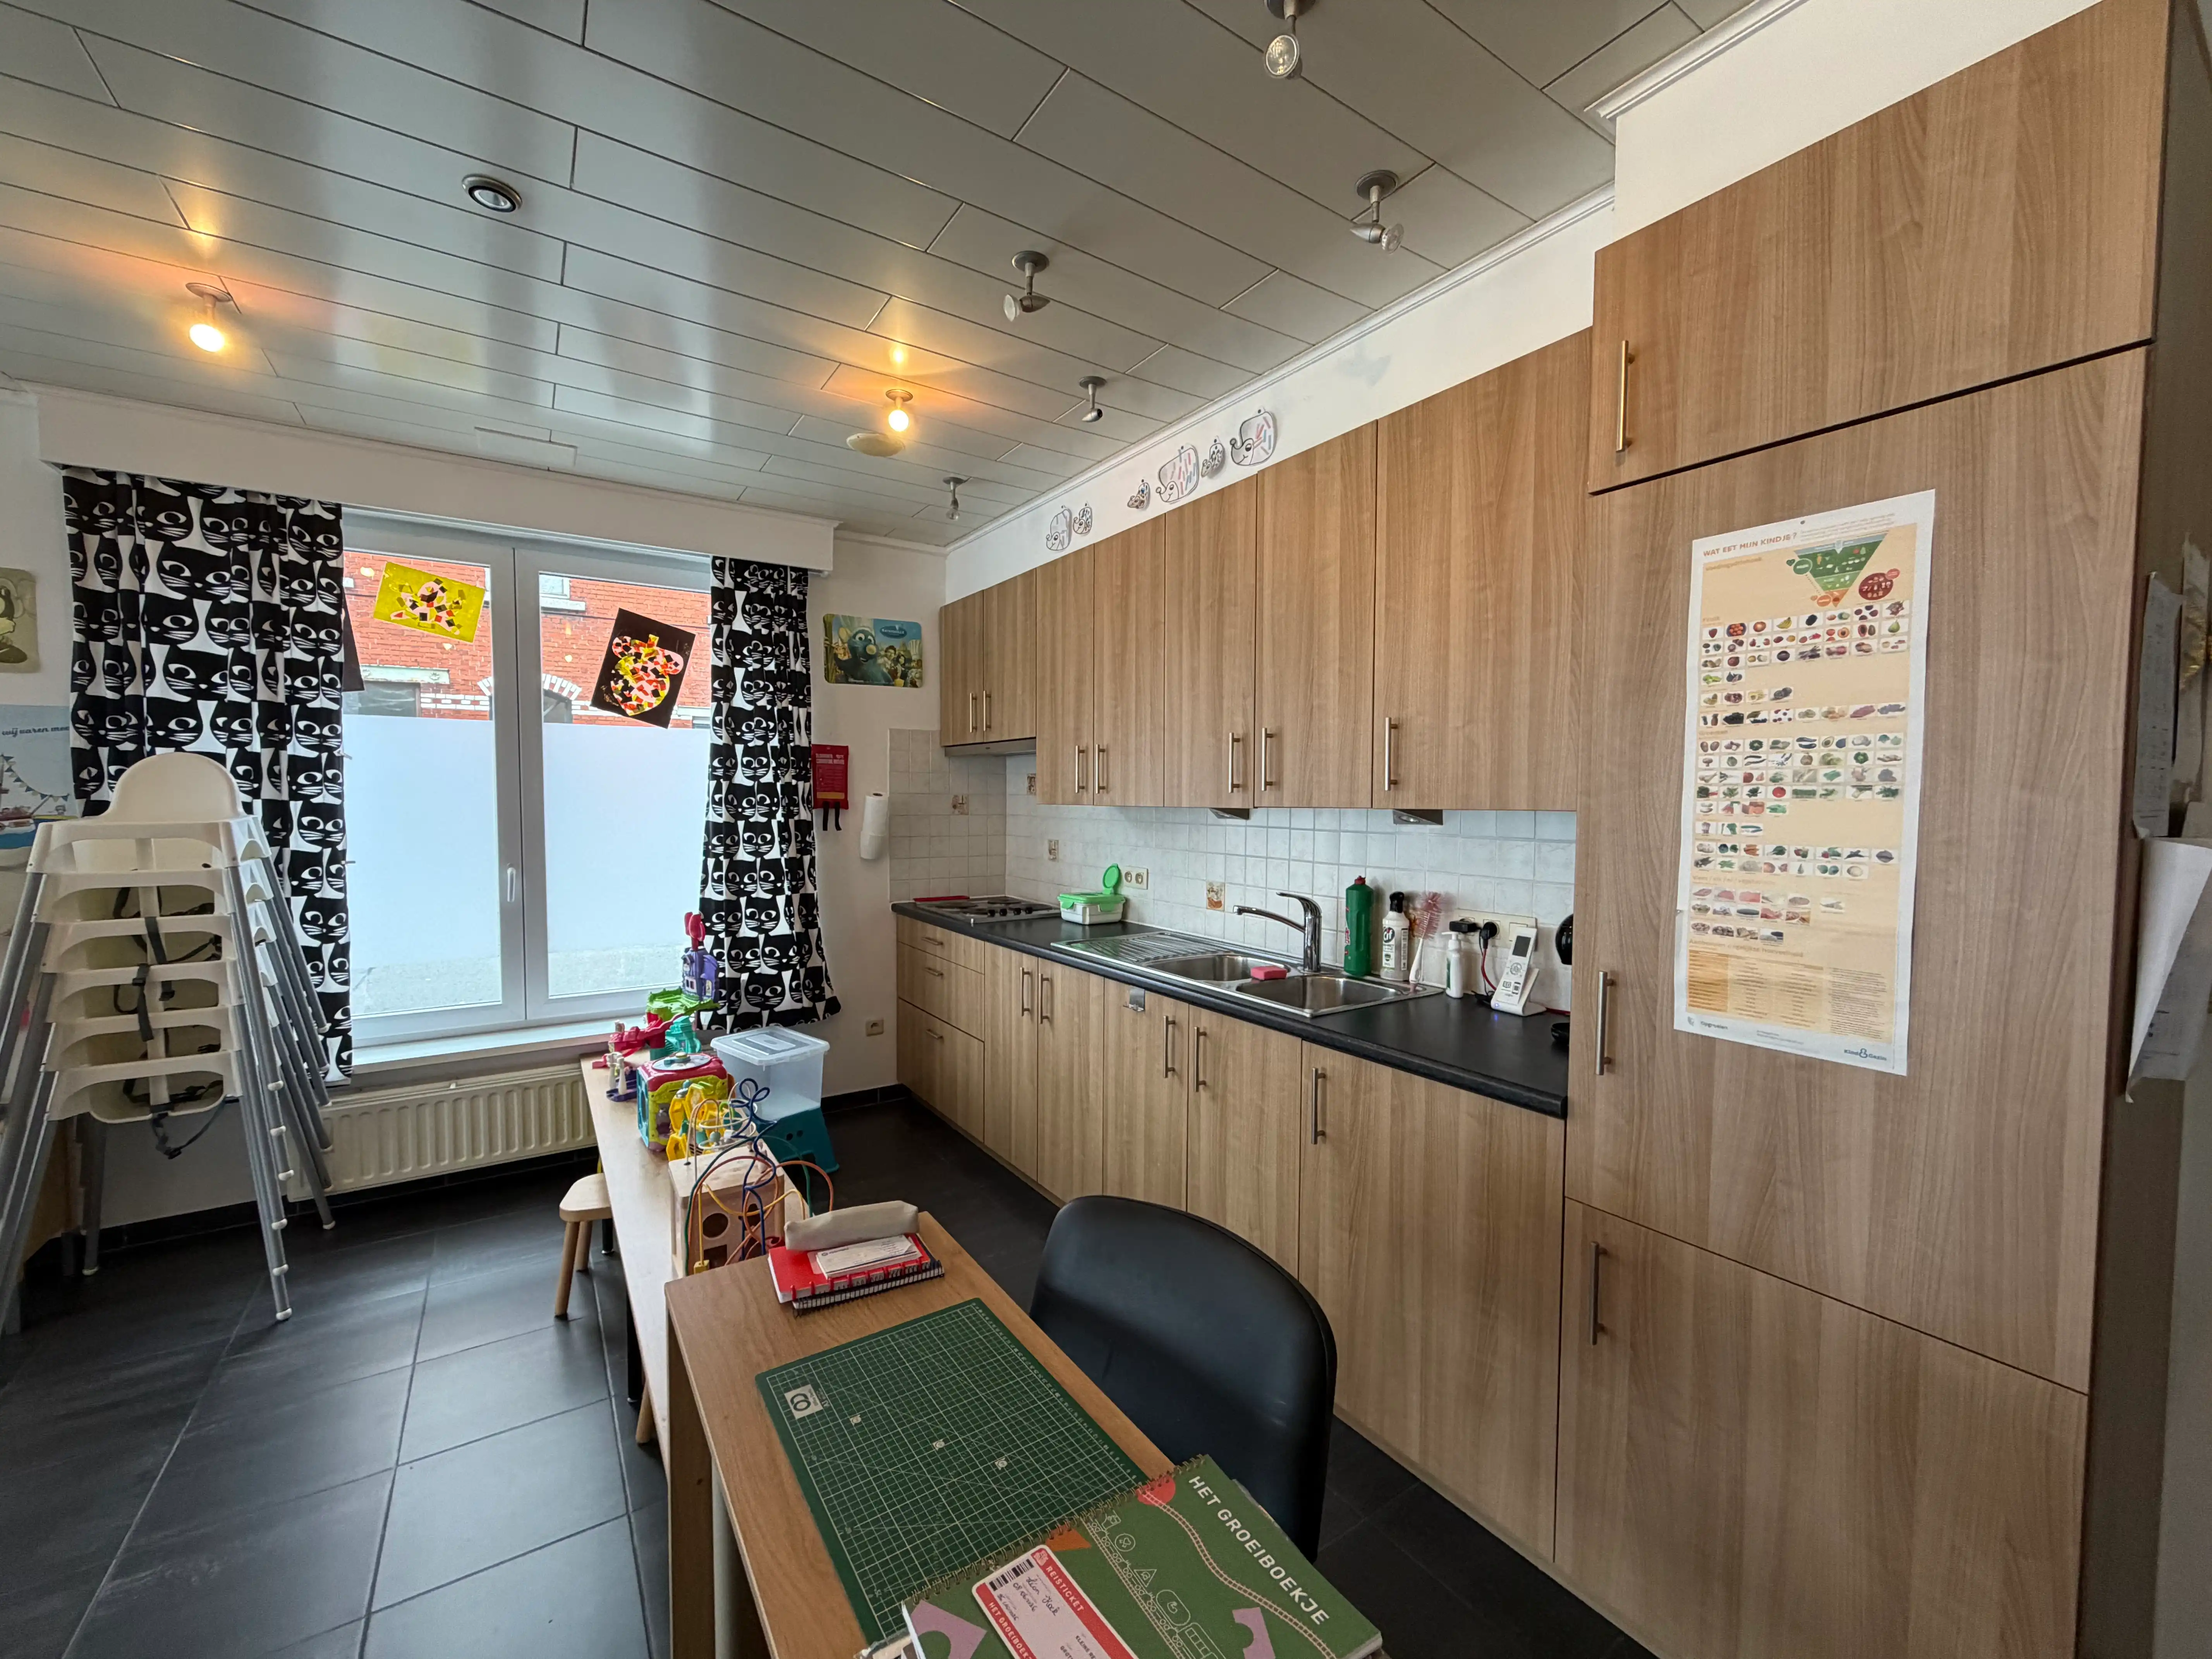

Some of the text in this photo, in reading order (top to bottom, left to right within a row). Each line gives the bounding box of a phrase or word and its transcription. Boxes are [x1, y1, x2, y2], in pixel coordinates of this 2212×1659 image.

[1703, 548, 1720, 556] WAT
[1723, 544, 1738, 553] EET
[1740, 541, 1758, 550] MIJN
[1760, 534, 1791, 546] KINDJE
[1384, 929, 1393, 941] cif
[1188, 1476, 1330, 1625] HET GROEIBOEKJE
[1046, 1566, 1084, 1611] REISTICKET
[988, 1602, 1001, 1616] HET
[999, 1617, 1033, 1659] GROEIBOEK
